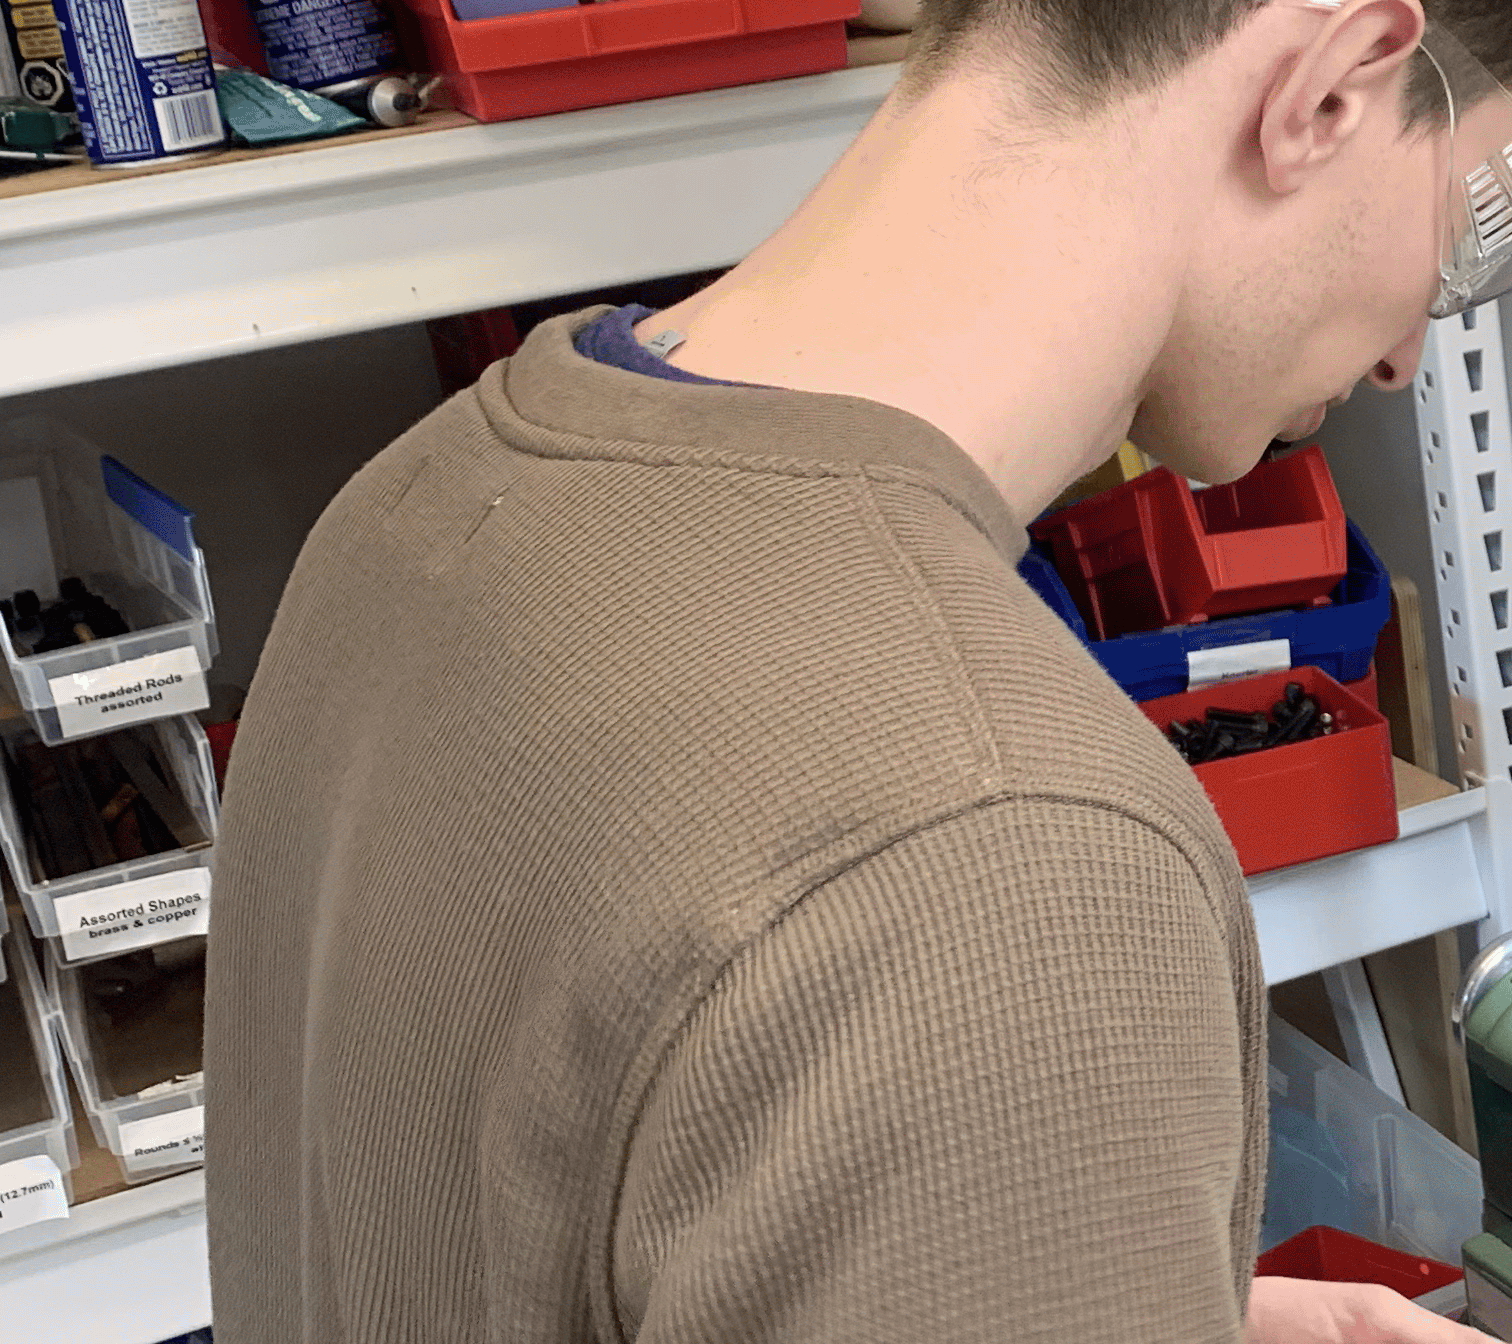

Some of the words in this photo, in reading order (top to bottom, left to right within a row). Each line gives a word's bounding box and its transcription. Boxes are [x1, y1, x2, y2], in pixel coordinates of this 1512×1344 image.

[74, 682, 142, 706] Threaded
[145, 674, 183, 689] Rods
[101, 691, 163, 713] assorted
[80, 903, 145, 928] Assorted
[148, 893, 202, 912] Shapes
[89, 924, 129, 939] brass
[133, 920, 144, 928] &
[148, 907, 197, 924] copper
[134, 1141, 179, 1156] Rounds
[0, 1179, 55, 1204] (12.7mm)
